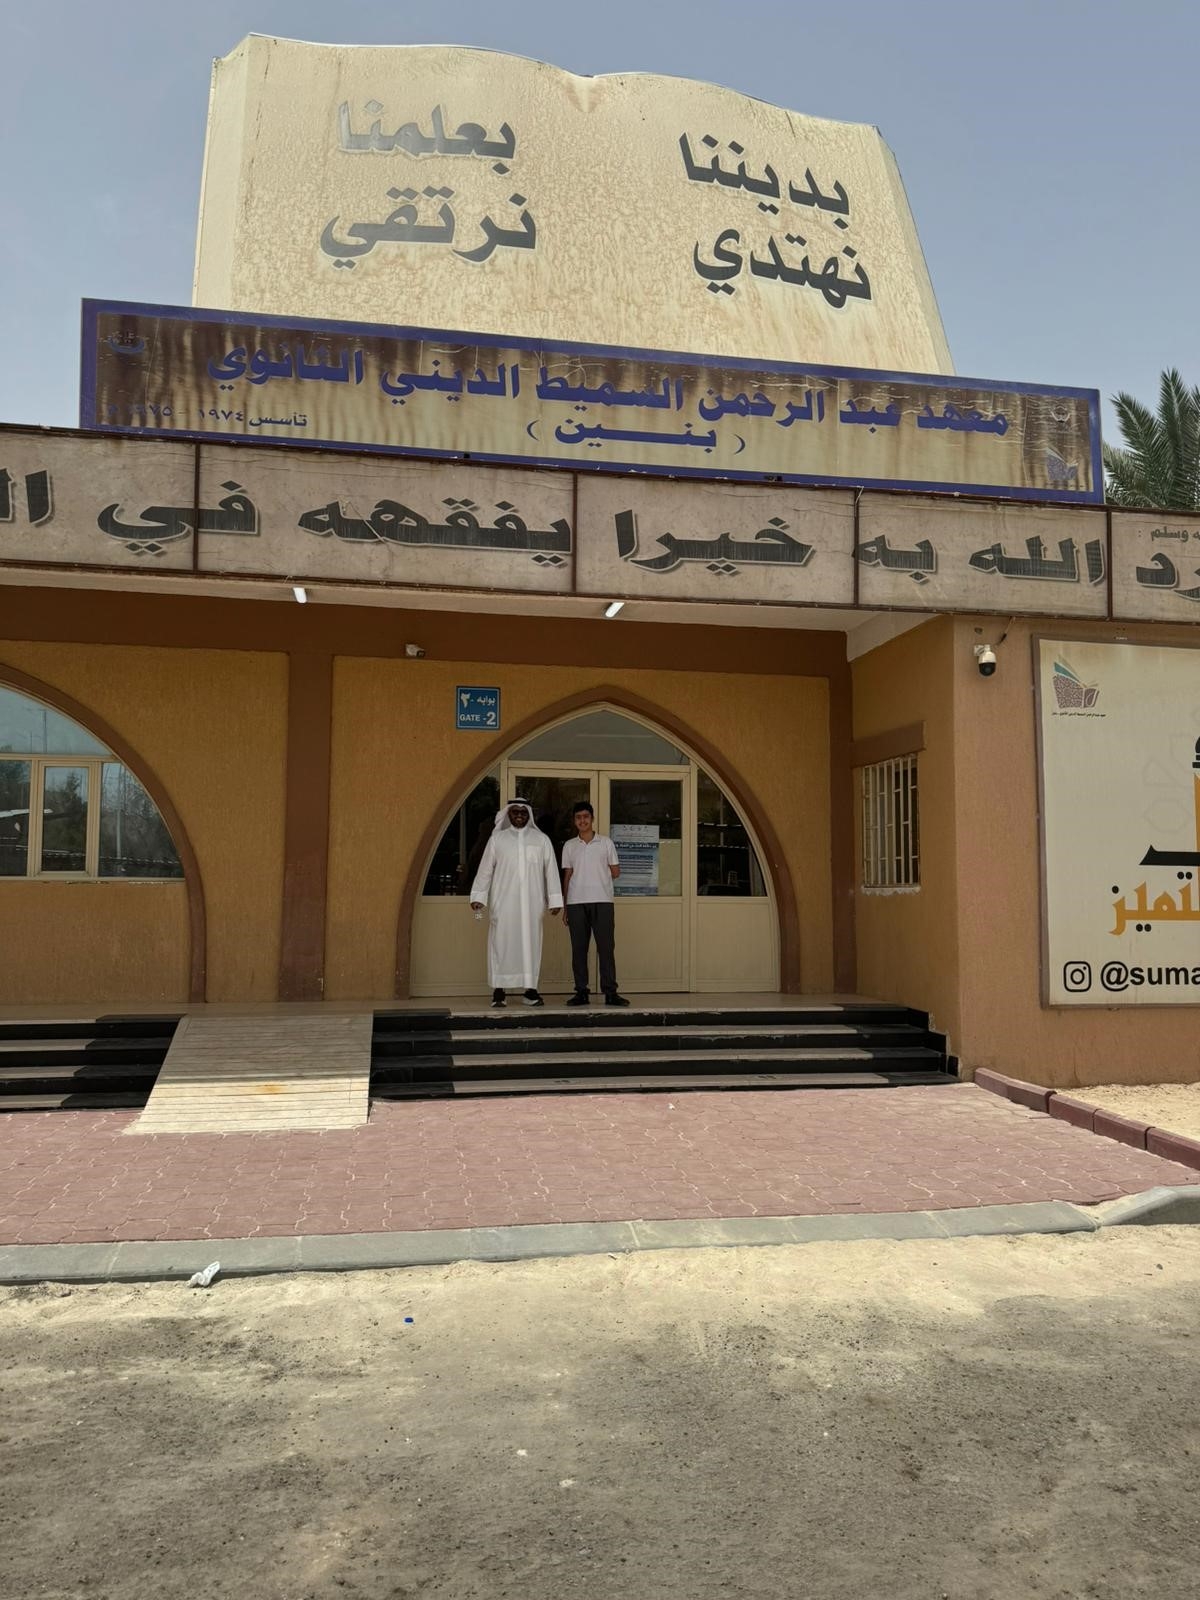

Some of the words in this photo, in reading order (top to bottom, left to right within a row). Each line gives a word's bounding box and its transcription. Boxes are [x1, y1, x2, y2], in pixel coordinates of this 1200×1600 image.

[337, 99, 517, 176] بعلمنا
[679, 131, 850, 231] بديننا
[321, 186, 537, 270] نرتقي
[693, 227, 872, 310] نهتدي
[207, 343, 366, 392] الثانوي
[380, 358, 521, 406] الديني
[535, 365, 685, 412] السميط
[128, 404, 173, 418] ٩٧٥
[199, 408, 245, 423] ١٩٧٤
[249, 411, 309, 428] تأسس
[698, 387, 826, 428] الرحمن
[838, 398, 902, 435] عبد
[916, 405, 1010, 437] معهد
[97, 480, 260, 555] في
[296, 497, 572, 567] يفقهه
[614, 508, 816, 575] خيرا
[1151, 526, 1190, 543] وسلم
[853, 534, 938, 584] به
[968, 535, 1106, 587] الله
[459, 713, 481, 722] GATE
